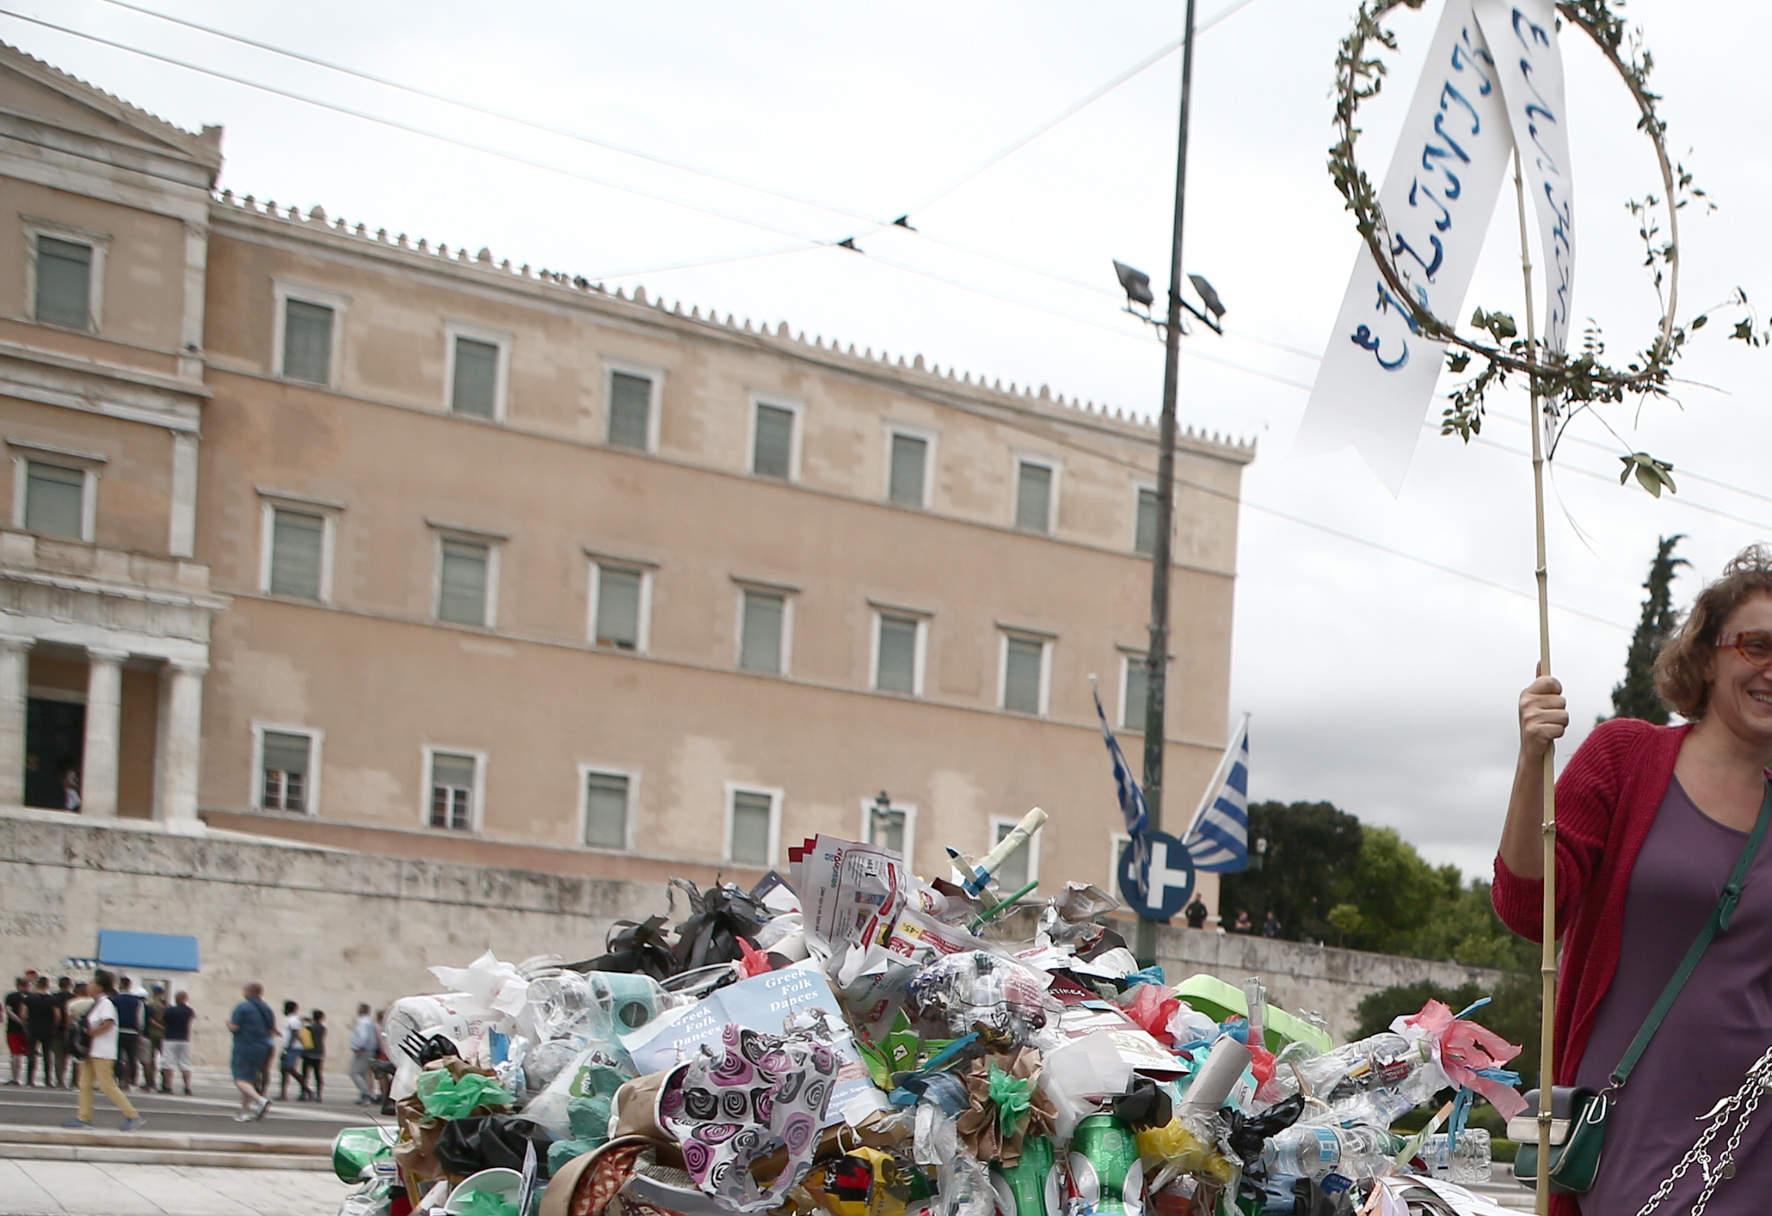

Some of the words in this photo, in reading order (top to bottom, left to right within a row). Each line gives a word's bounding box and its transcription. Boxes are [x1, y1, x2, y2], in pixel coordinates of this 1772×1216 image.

[764, 967, 808, 990] Greek
[780, 978, 813, 997] Folk
[769, 989, 820, 1013] Dances
[669, 1005, 713, 1029] Greek
[684, 1015, 717, 1034] Folk
[672, 1023, 722, 1049] Dances
